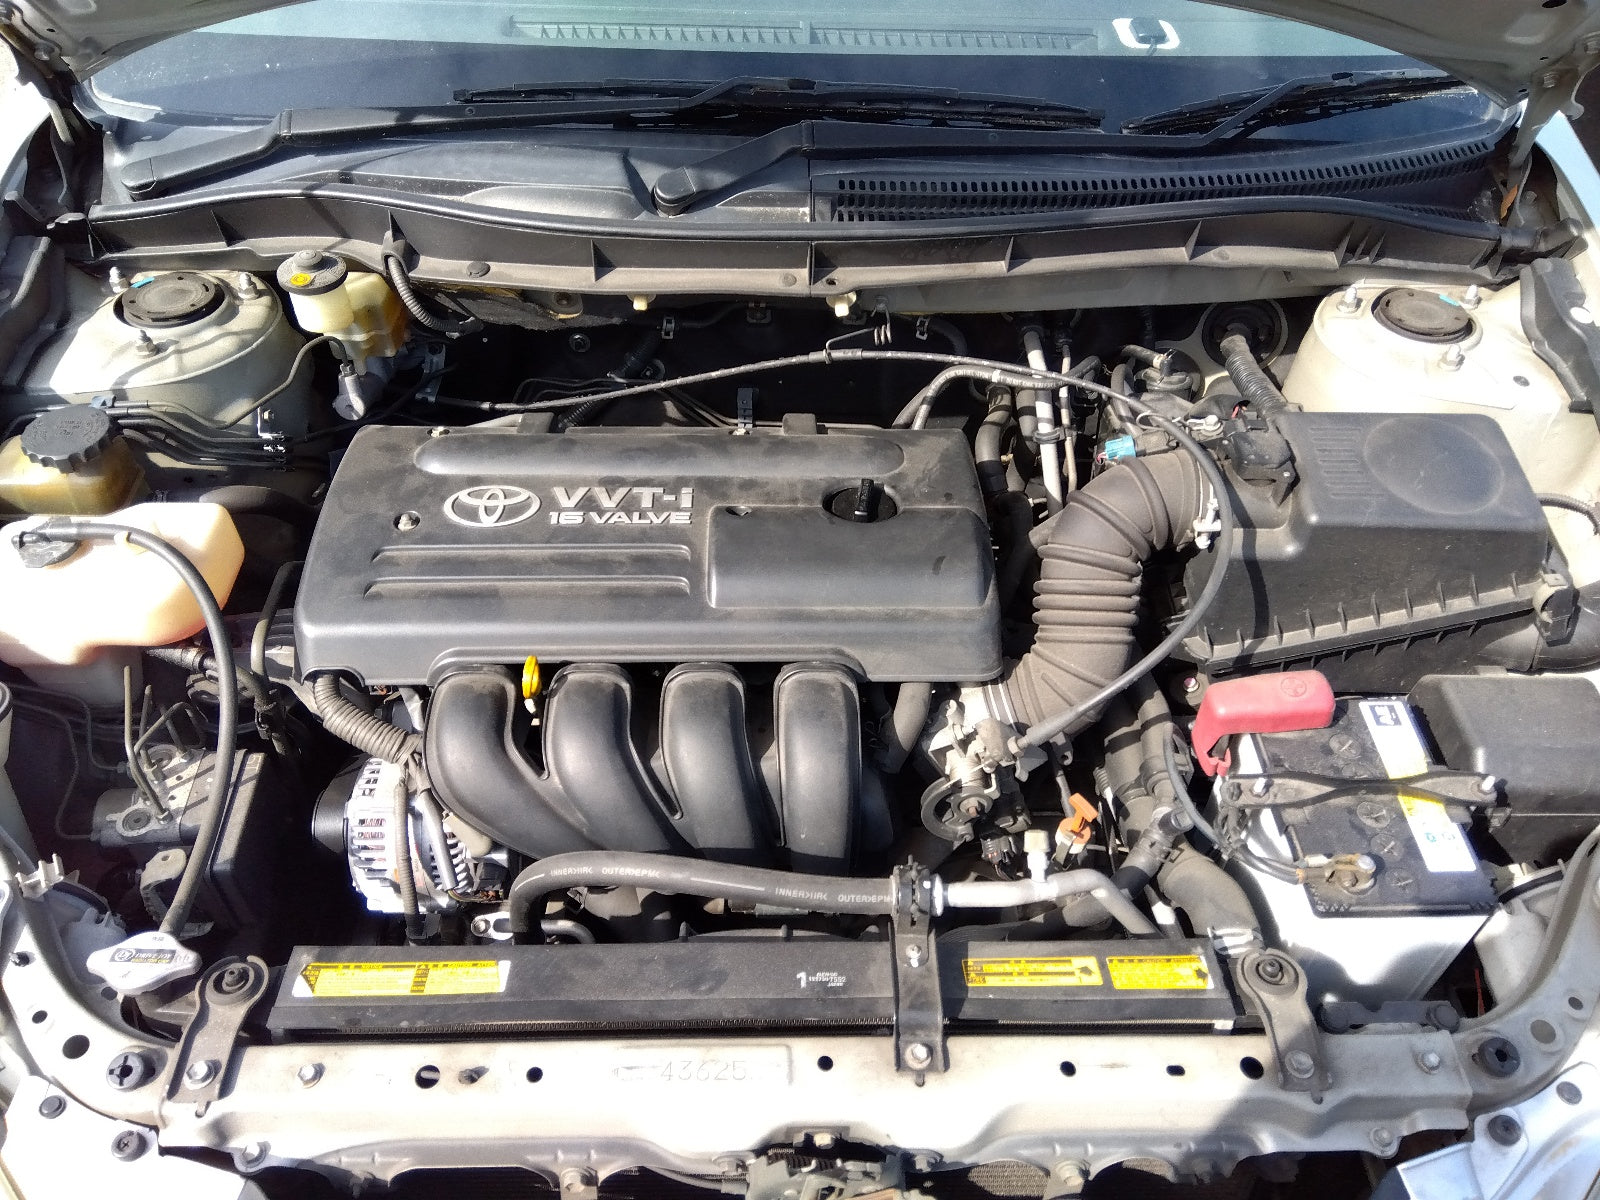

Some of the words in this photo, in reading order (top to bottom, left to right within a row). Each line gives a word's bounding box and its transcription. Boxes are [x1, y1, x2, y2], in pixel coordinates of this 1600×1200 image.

[553, 487, 695, 509] VVT-i
[549, 511, 585, 525] 16
[589, 511, 693, 525] VALVE
